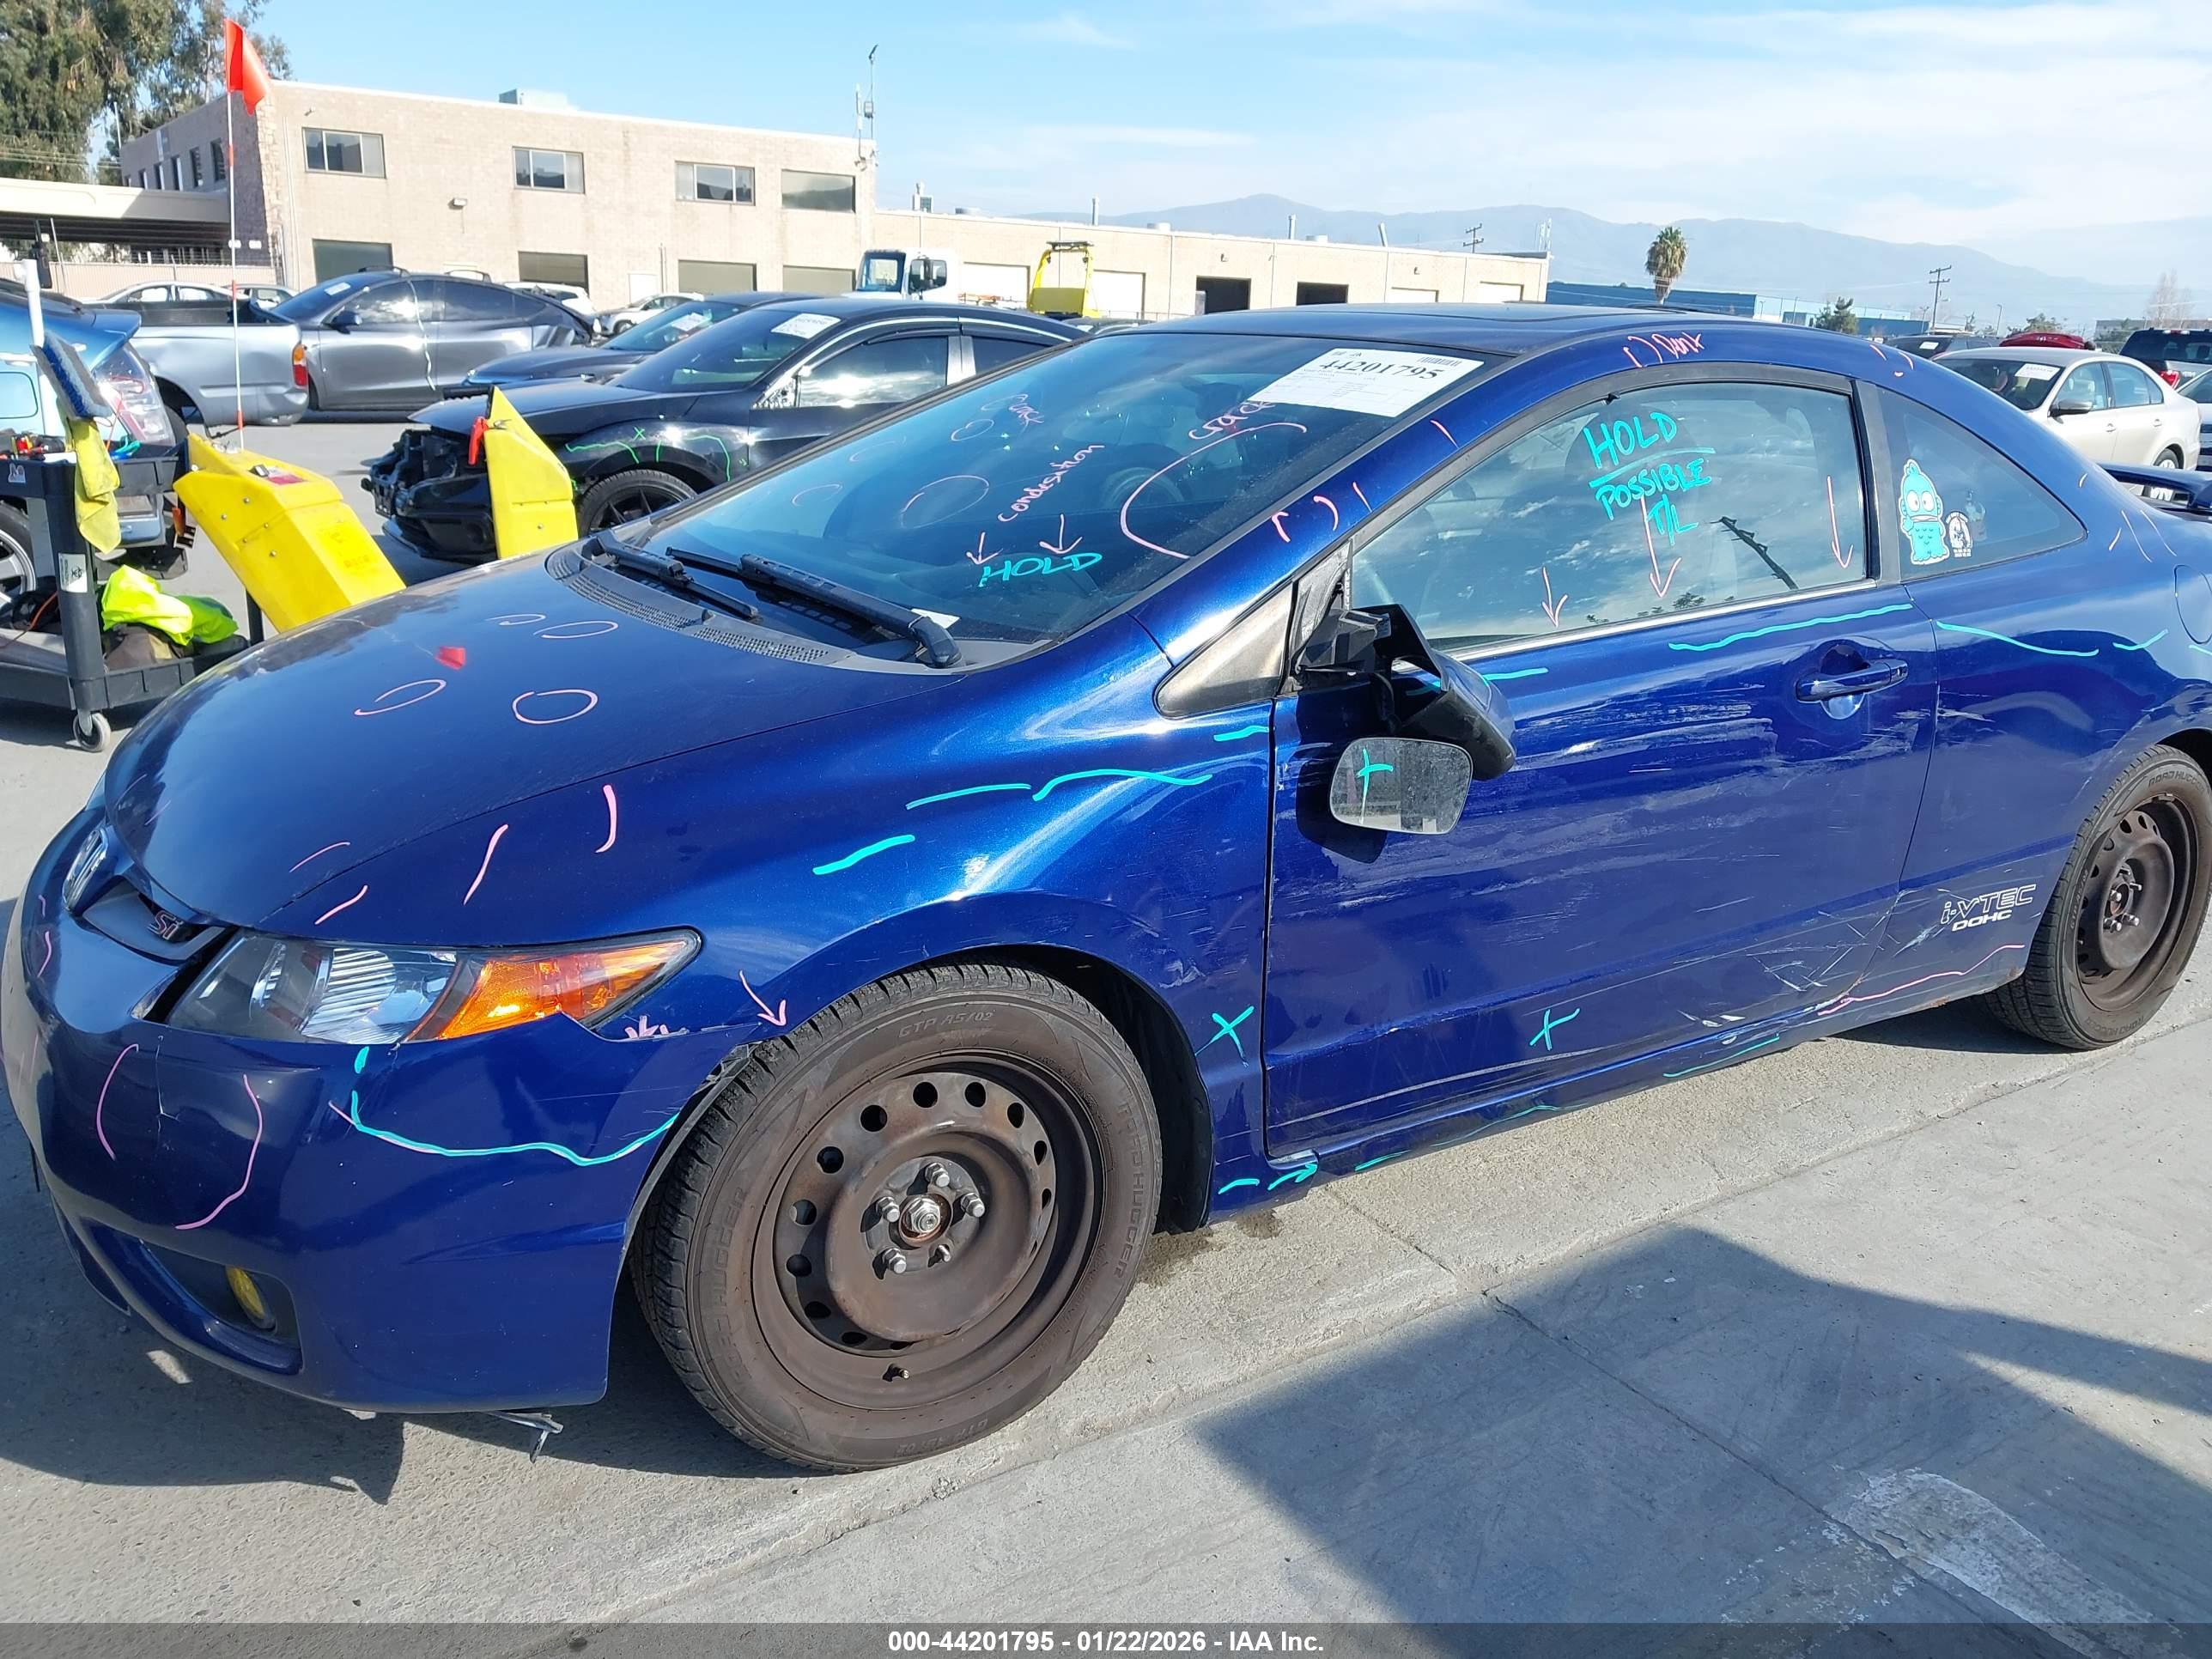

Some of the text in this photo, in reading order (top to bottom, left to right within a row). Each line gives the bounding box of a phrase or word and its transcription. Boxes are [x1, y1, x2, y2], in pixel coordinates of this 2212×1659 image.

[1319, 359, 1445, 380] 44201795
[1582, 410, 1677, 470] HOLD
[1595, 457, 1712, 521] POSSIBLE
[978, 552, 1103, 587] HOLD
[147, 910, 185, 940] Si
[1951, 909, 2013, 933] DOHC
